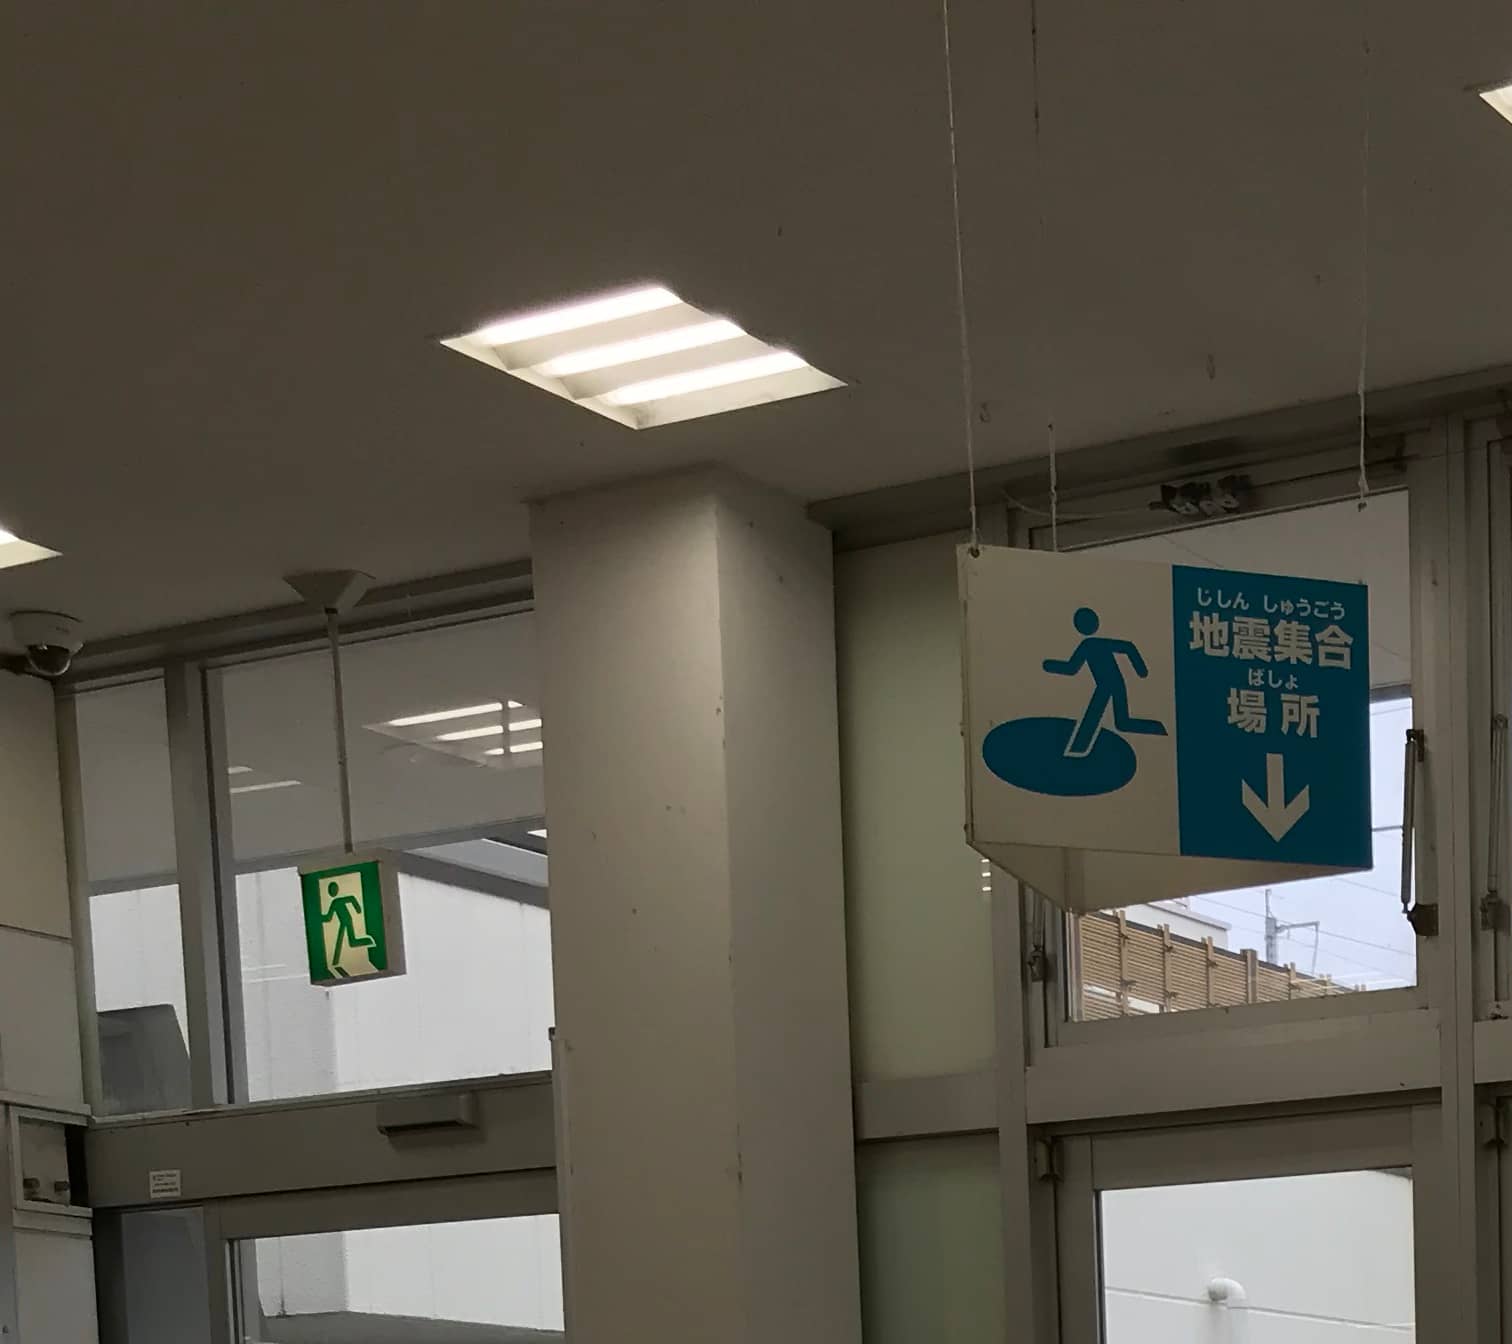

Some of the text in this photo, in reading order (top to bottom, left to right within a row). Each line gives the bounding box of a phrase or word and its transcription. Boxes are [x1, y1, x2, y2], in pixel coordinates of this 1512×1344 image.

[1197, 587, 1346, 620] じしん しゅうごう
[1188, 611, 1354, 671] 地震集合
[1248, 667, 1299, 689] ばしょ
[1227, 687, 1321, 739] 場所
